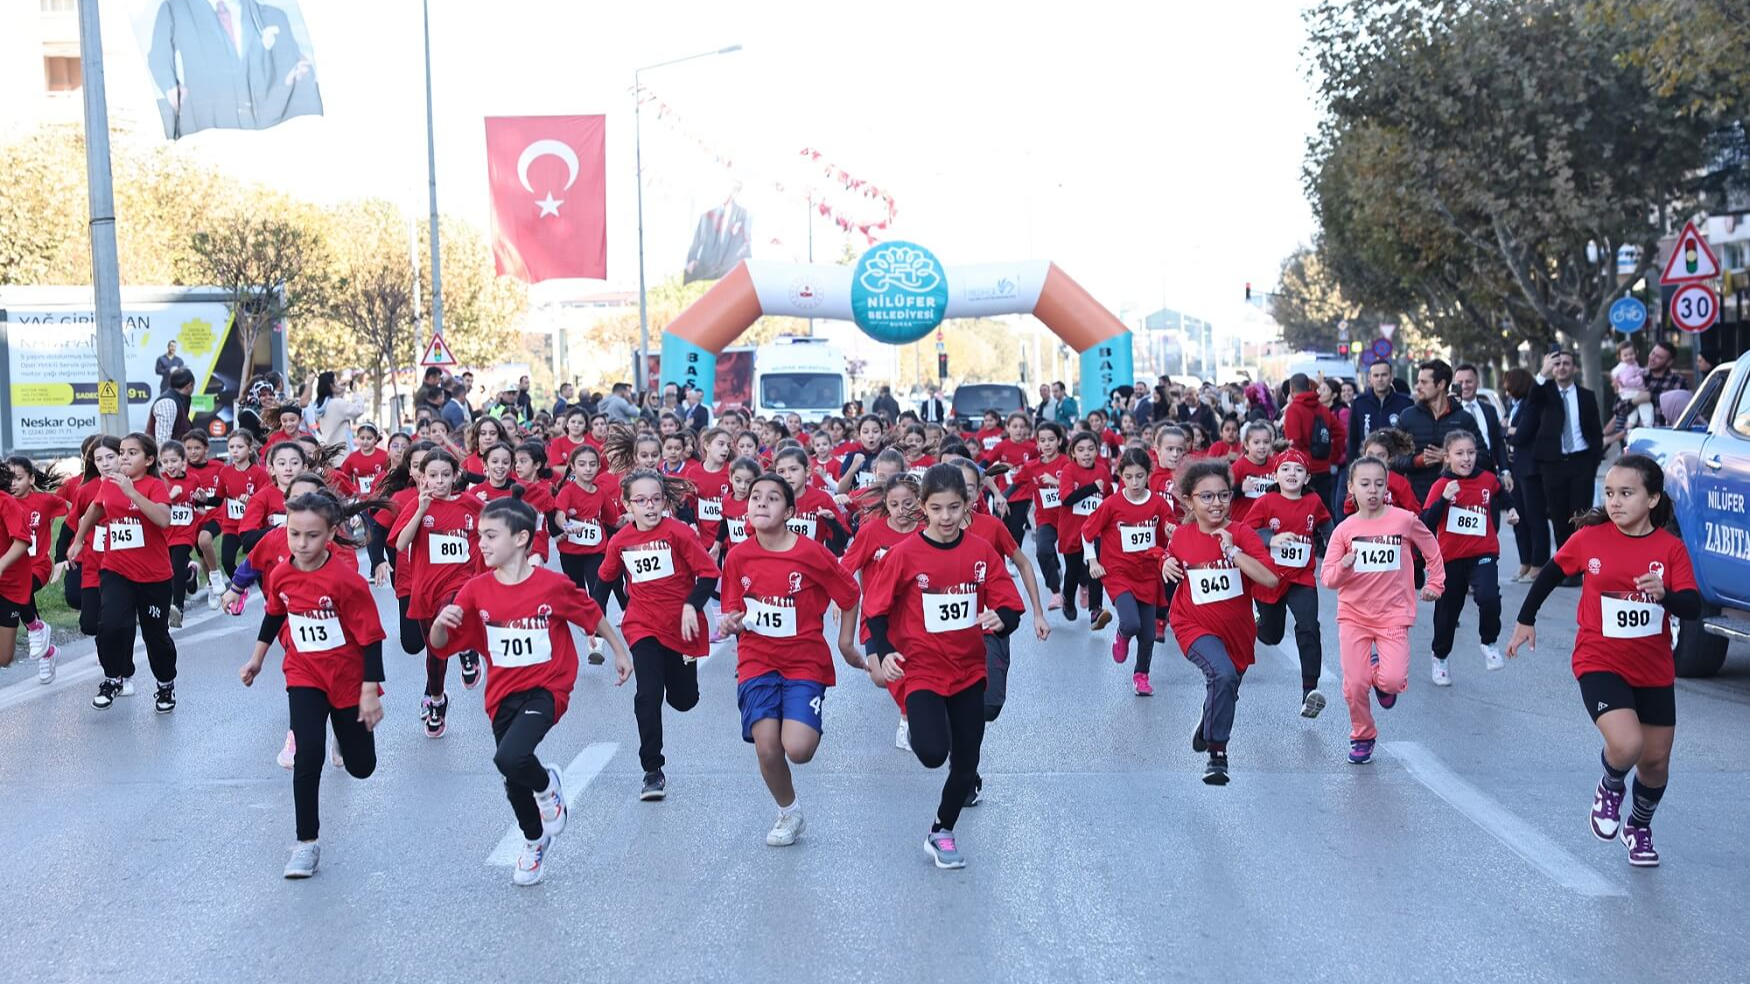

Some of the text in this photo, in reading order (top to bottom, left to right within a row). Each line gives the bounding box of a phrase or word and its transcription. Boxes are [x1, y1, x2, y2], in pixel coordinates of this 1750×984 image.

[867, 293, 936, 308] NİLÜFER
[1681, 297, 1709, 318] 30
[868, 308, 934, 320] BELEDİYESİ
[20, 416, 96, 429] Neskar Opel
[1081, 500, 1097, 510] 410
[1708, 485, 1745, 514] NİLÜFER
[172, 511, 189, 520] 587
[704, 506, 720, 515] 406
[1457, 515, 1478, 528] 862
[111, 529, 132, 543] 945
[1131, 532, 1151, 545] 979
[1704, 521, 1750, 561] ZABITA
[441, 542, 463, 556] 801
[1280, 547, 1302, 560] 991
[1361, 549, 1395, 564] 1420
[634, 556, 661, 574] 392
[1200, 575, 1230, 594] 940
[938, 600, 969, 621] 397
[1617, 609, 1650, 628] 990
[299, 626, 328, 642] 113
[500, 636, 533, 656] 701
[809, 695, 821, 715] 4
